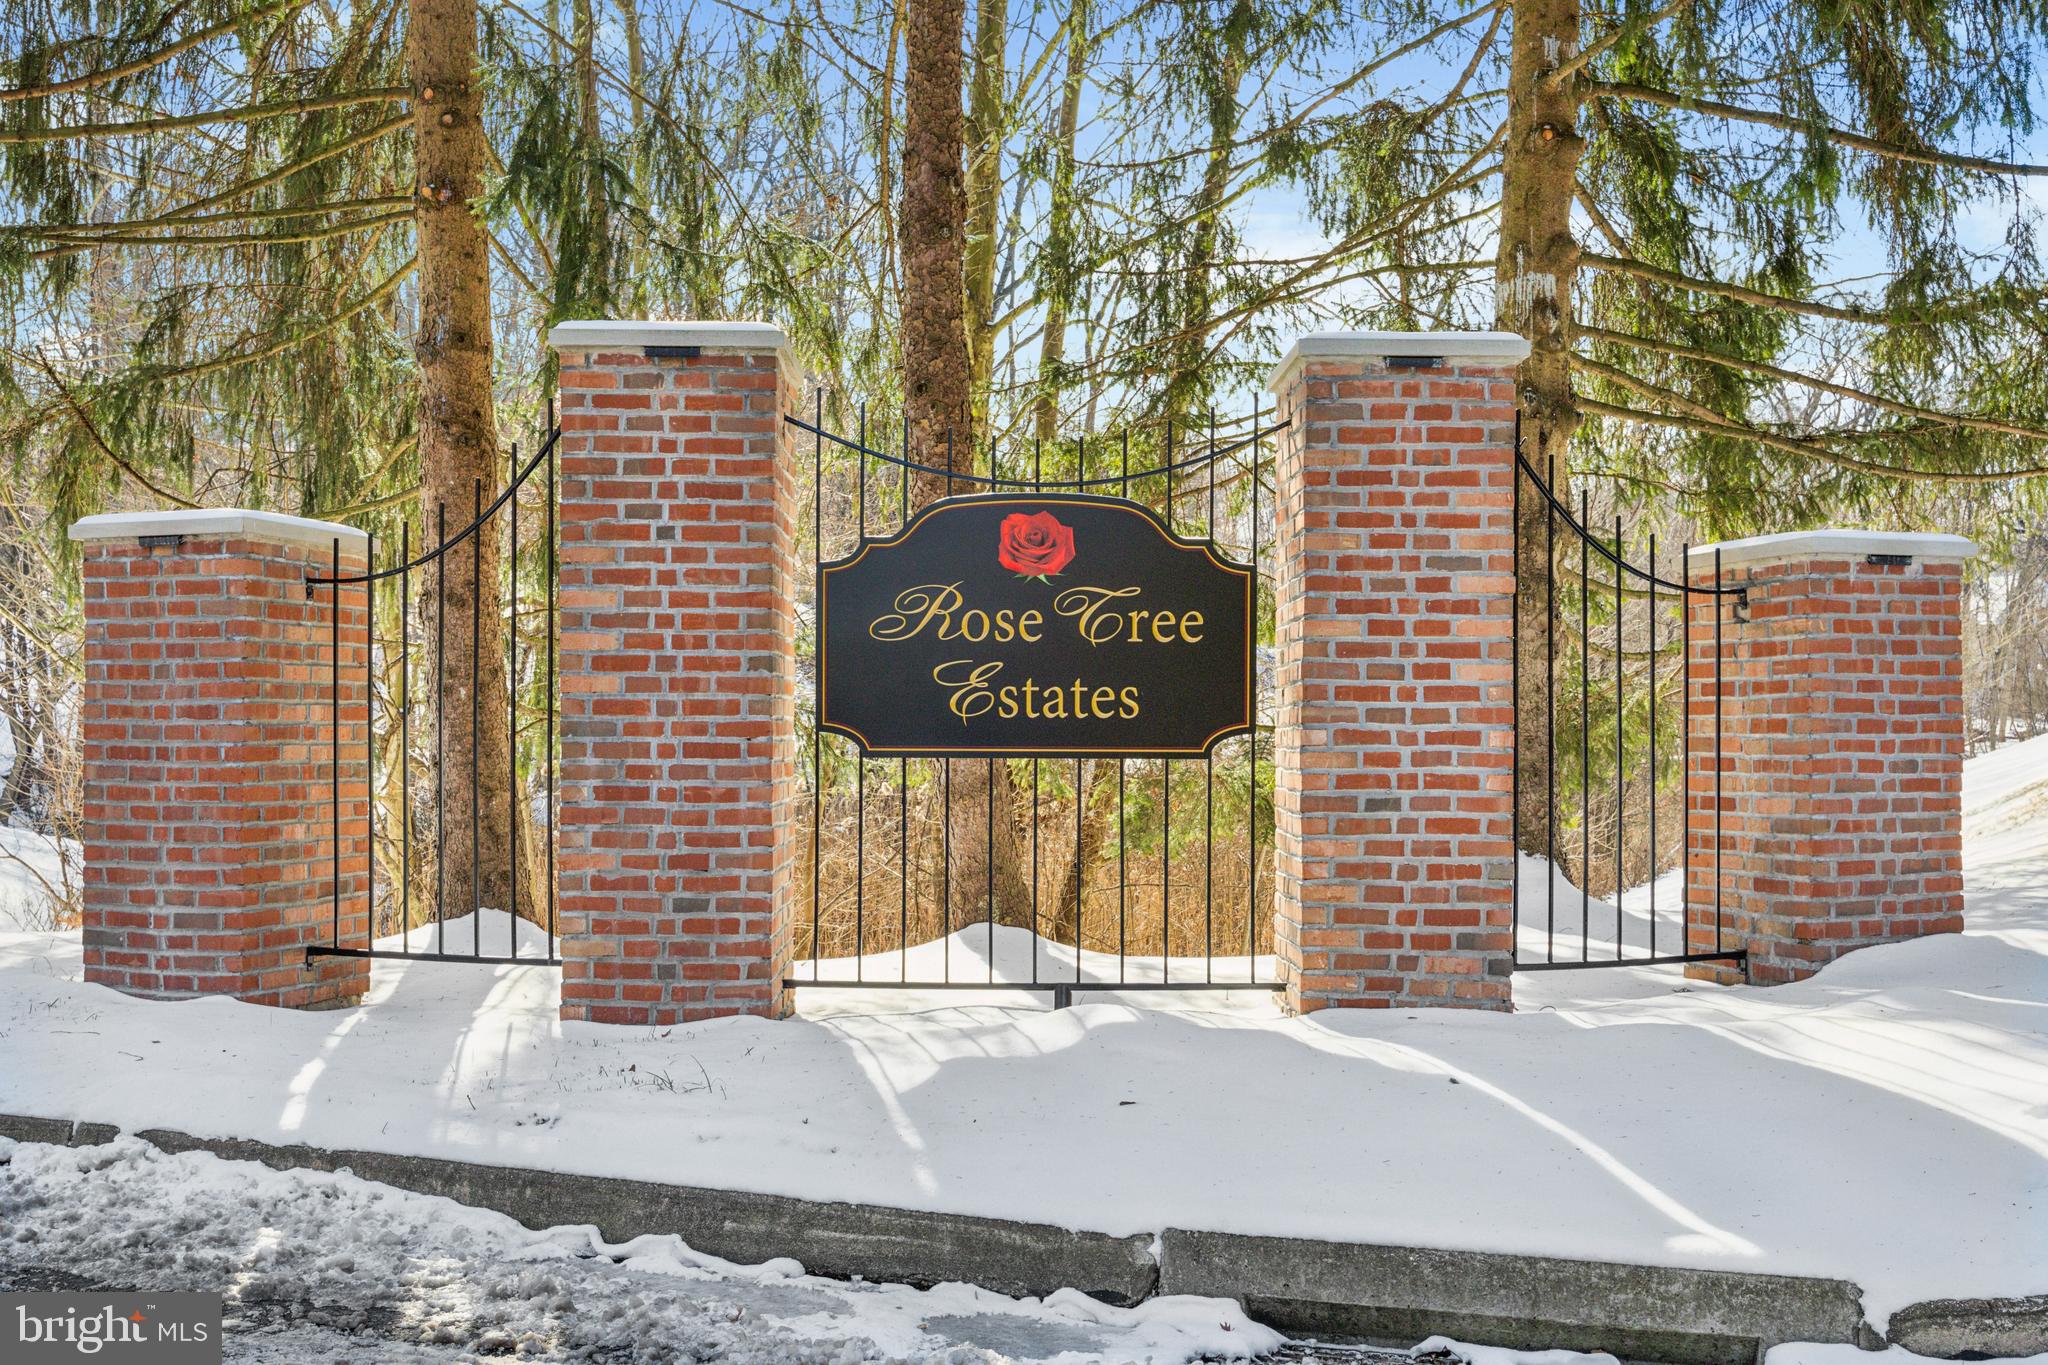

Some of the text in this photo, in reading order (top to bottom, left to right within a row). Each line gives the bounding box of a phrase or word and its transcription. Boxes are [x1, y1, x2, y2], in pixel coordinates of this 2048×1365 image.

[869, 580, 1204, 648] Rose Tree
[933, 660, 1140, 727] Estates
